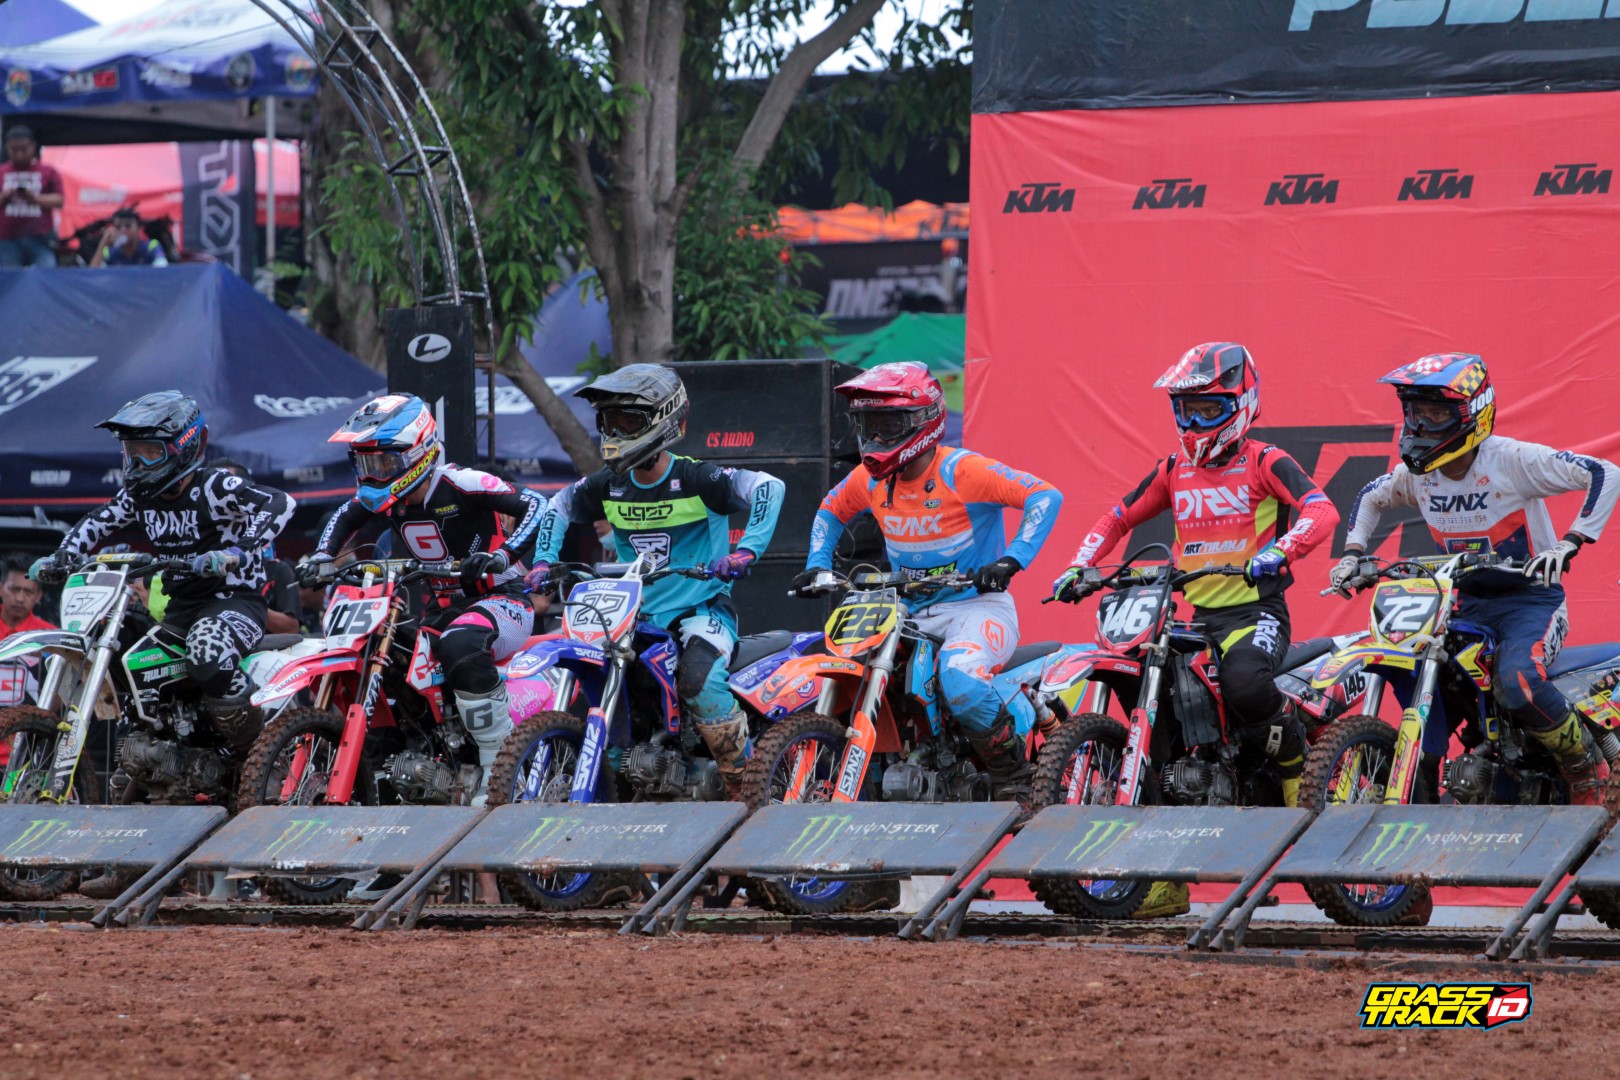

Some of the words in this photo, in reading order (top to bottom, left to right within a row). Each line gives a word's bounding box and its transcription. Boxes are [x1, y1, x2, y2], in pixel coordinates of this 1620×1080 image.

[1133, 178, 1207, 210] KTM
[1264, 174, 1339, 205] KTM
[1398, 168, 1474, 201] KTM
[1534, 163, 1613, 196] KTM
[1003, 182, 1075, 213] KTM
[706, 432, 720, 448] CS
[721, 431, 755, 448] AUDIO
[64, 591, 108, 613] 57
[325, 601, 376, 636] 105
[572, 593, 627, 627] 22
[1102, 596, 1158, 637] 146
[1378, 596, 1436, 633] 72
[829, 606, 893, 641] 122
[1341, 671, 1366, 705] 146
